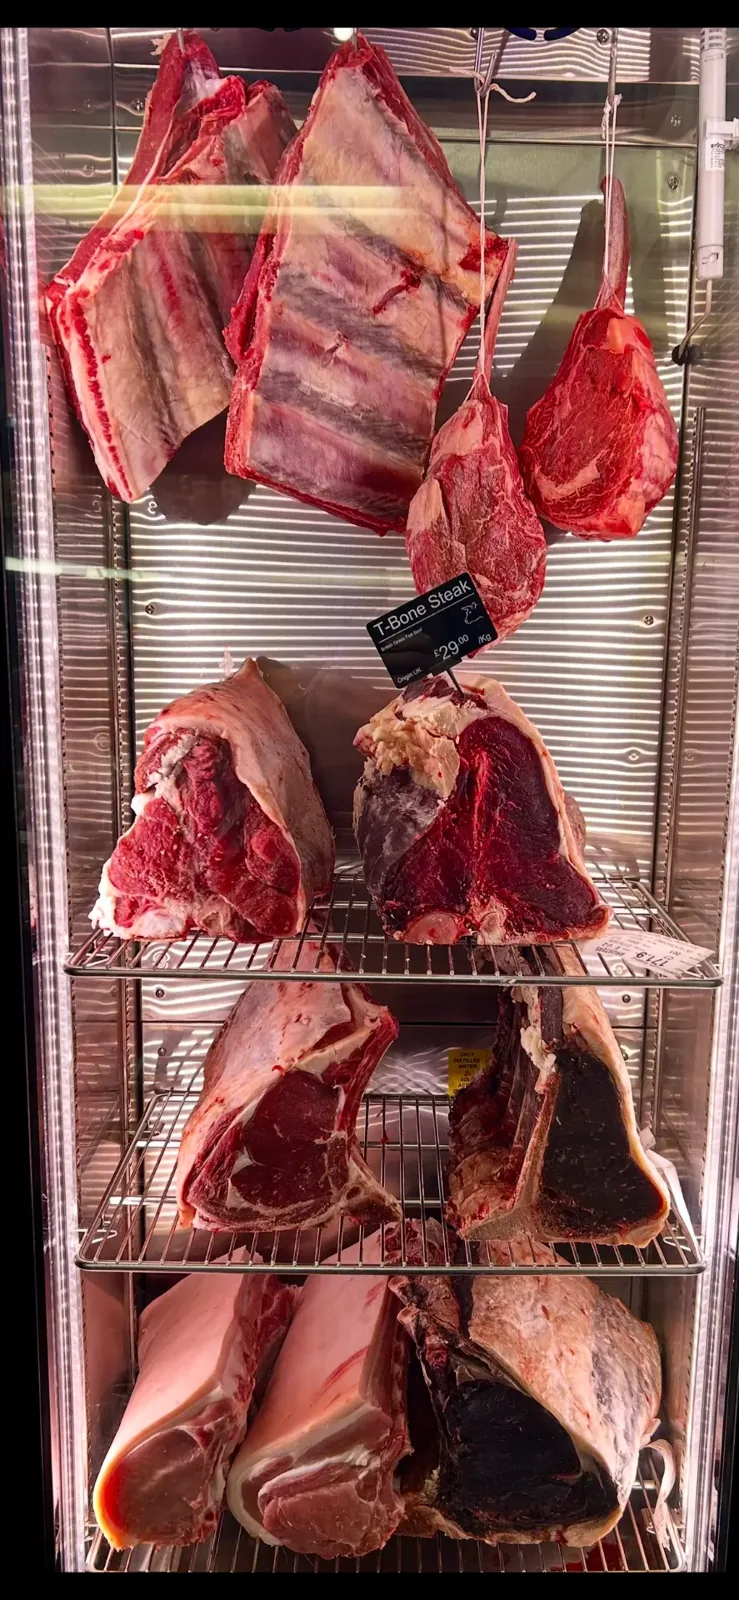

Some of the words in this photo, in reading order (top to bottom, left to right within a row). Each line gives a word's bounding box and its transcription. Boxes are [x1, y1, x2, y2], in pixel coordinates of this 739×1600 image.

[373, 603, 427, 636] T-Bone
[428, 579, 472, 609] Steak
[478, 633, 492, 645] /Kg
[397, 670, 413, 684] Origin
[412, 667, 423, 677] UK
